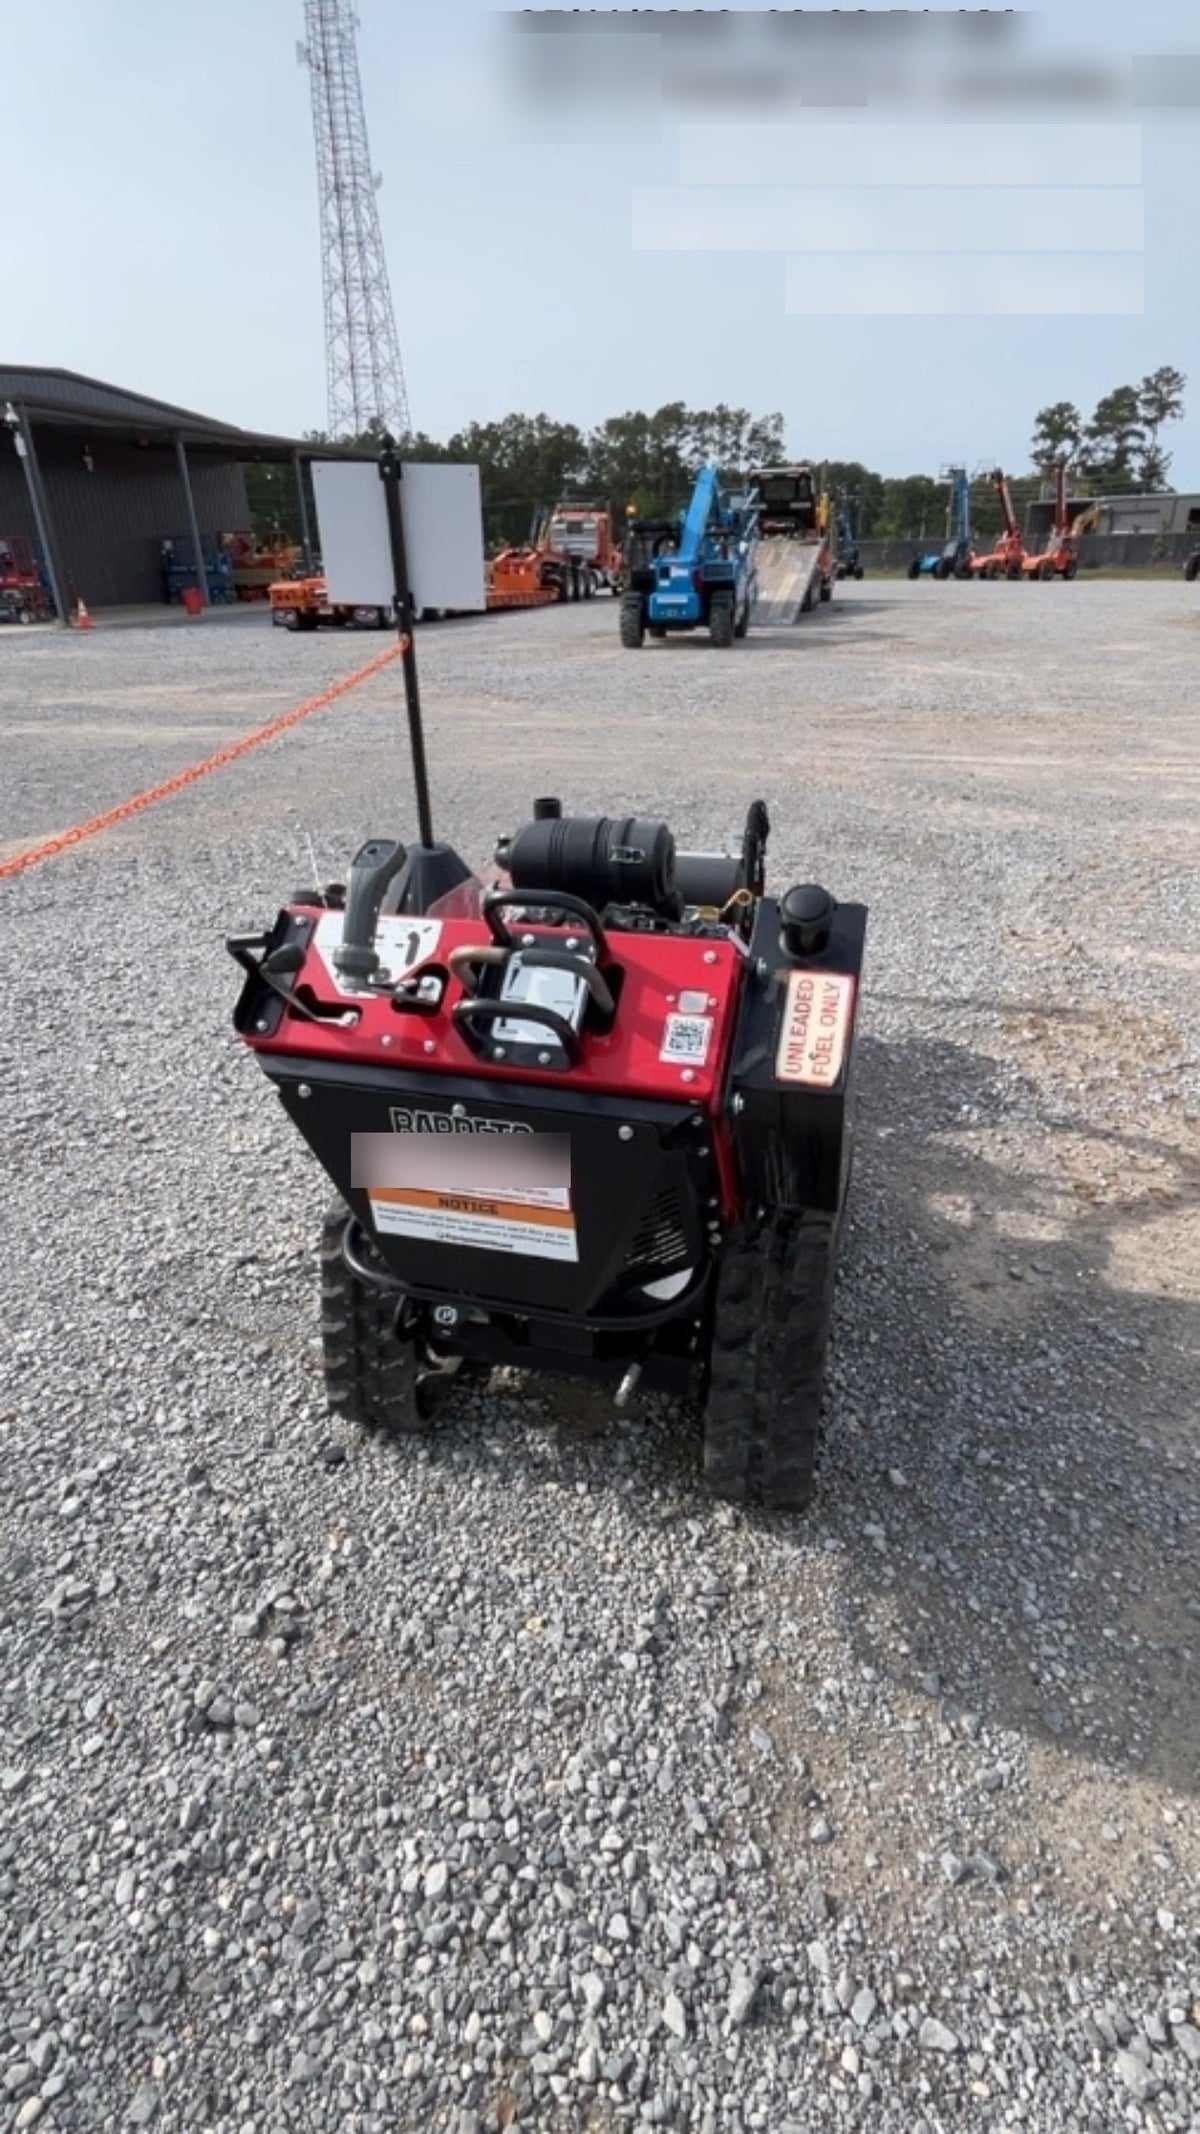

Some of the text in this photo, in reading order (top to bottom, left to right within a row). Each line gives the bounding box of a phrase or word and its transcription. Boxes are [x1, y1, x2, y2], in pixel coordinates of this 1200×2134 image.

[785, 979, 814, 1074] UNLEADED
[811, 981, 841, 1076] FUEL ONLY
[438, 1197, 499, 1215] NOTICE
